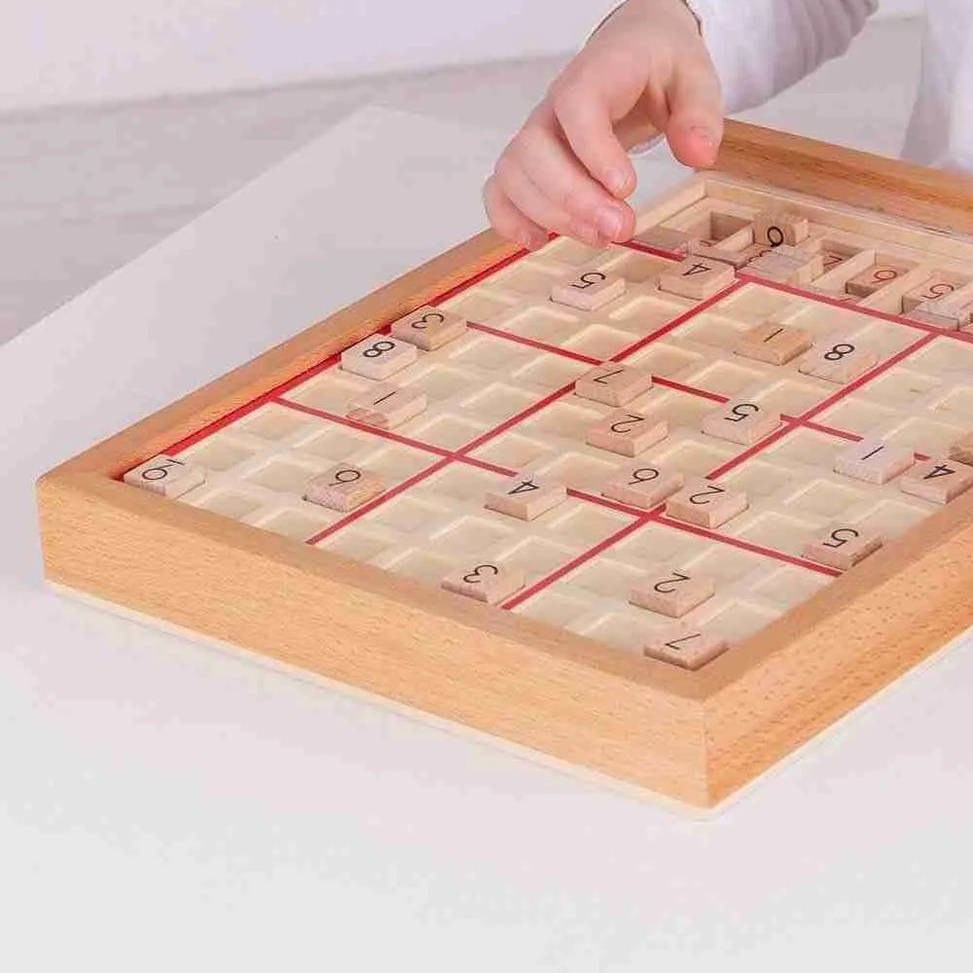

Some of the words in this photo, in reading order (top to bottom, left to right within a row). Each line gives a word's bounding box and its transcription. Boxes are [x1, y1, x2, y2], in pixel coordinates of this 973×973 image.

[683, 262, 711, 276] 4
[572, 273, 606, 288] 5
[411, 313, 444, 328] 3
[363, 340, 395, 358] 8
[824, 344, 854, 360] 8
[724, 403, 759, 422] 5
[611, 415, 644, 433] 2
[922, 464, 956, 479] 4
[507, 479, 540, 495] 4
[690, 486, 724, 504] 2
[823, 529, 858, 548] 5
[463, 565, 498, 583] 3
[654, 573, 690, 593] 2
